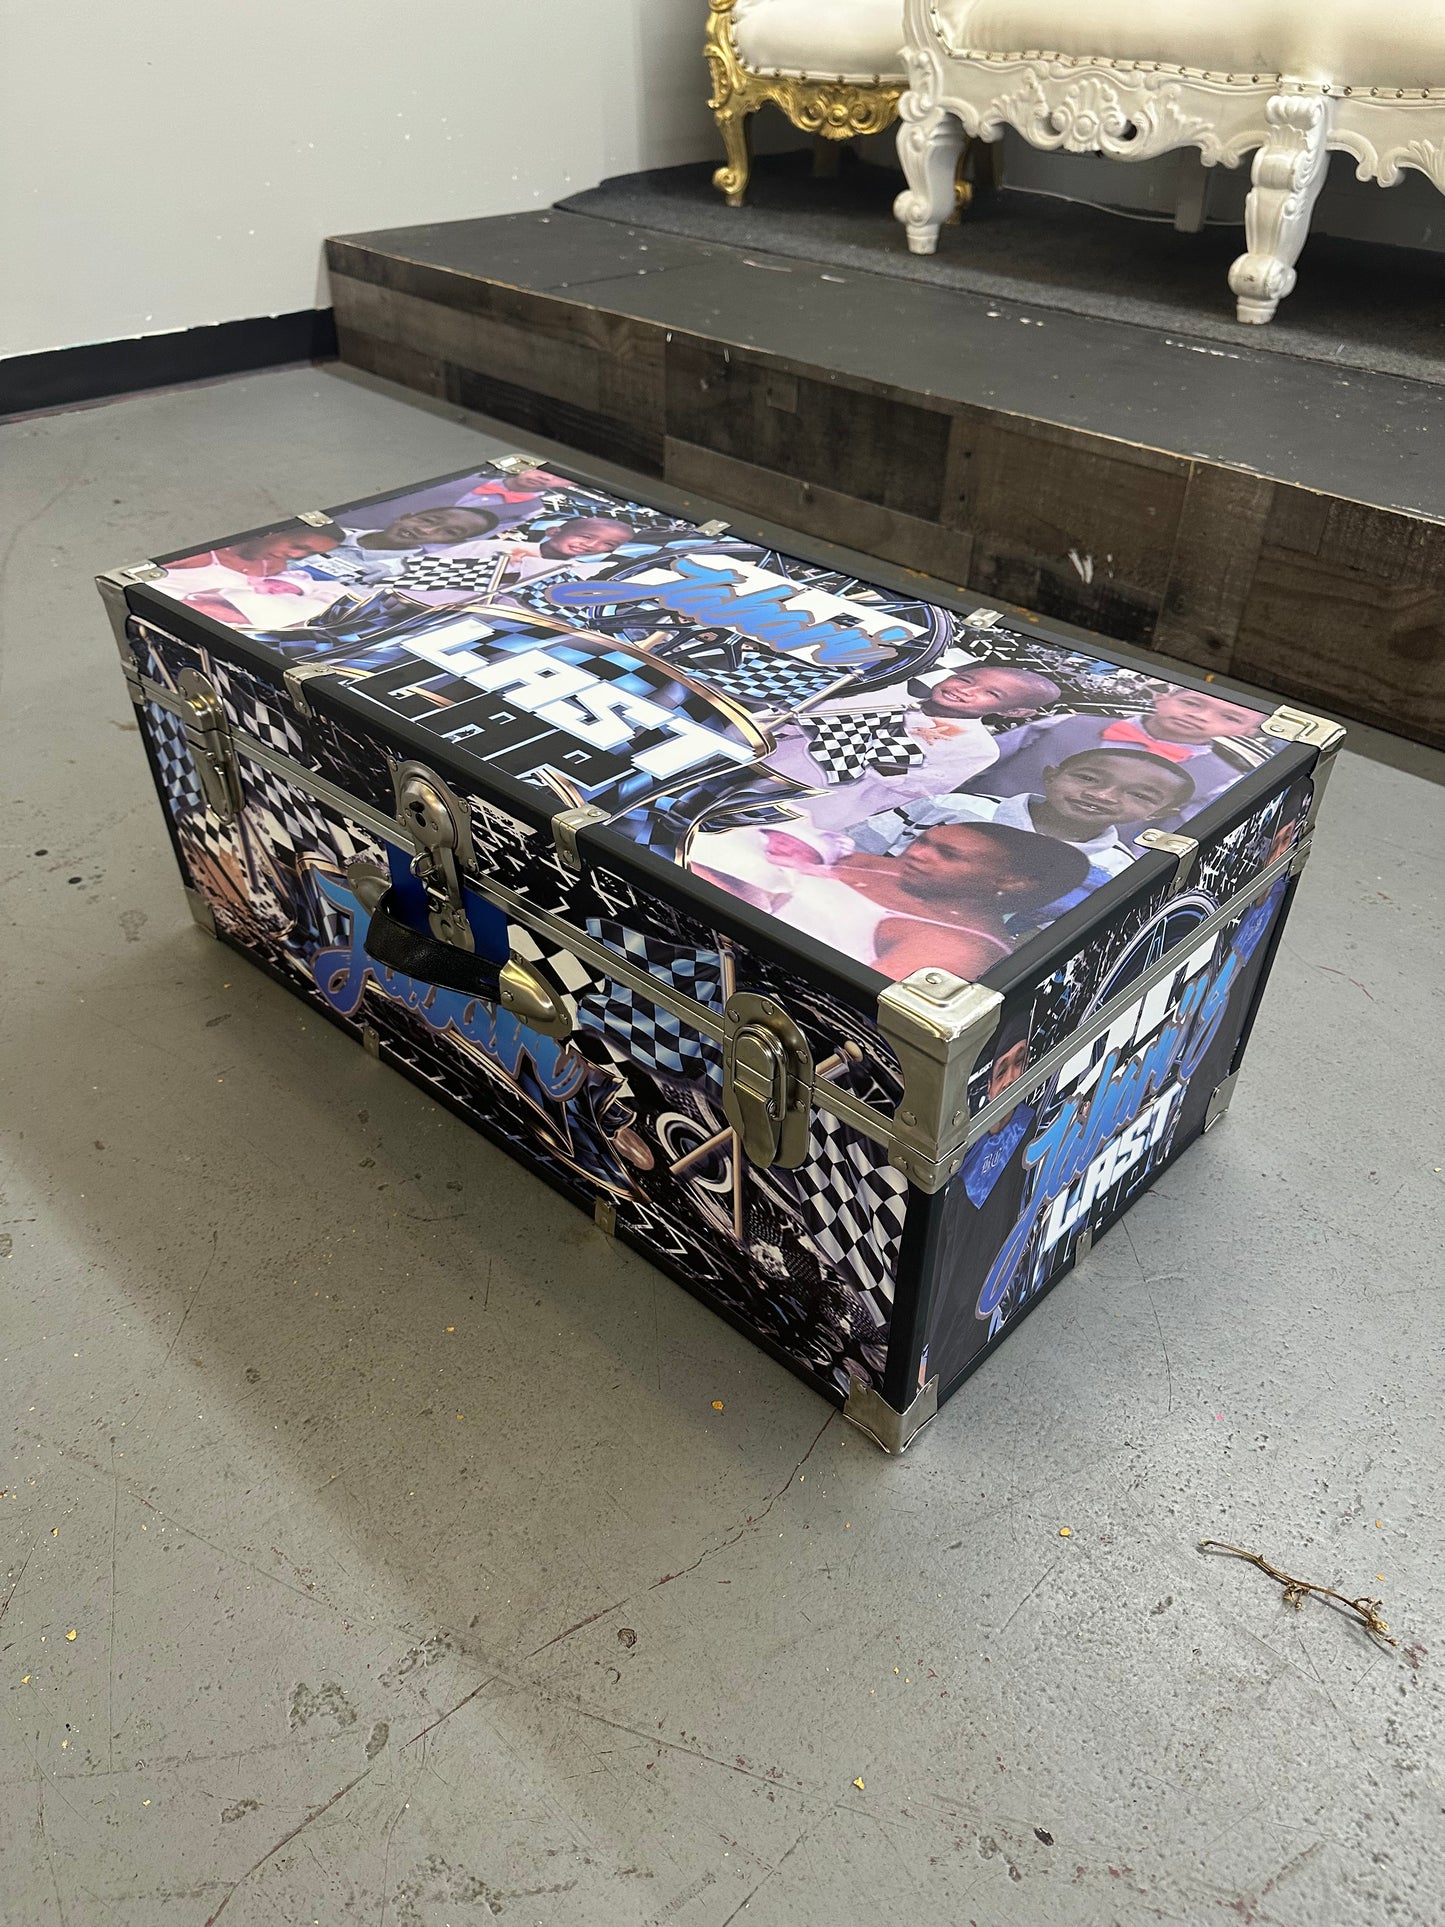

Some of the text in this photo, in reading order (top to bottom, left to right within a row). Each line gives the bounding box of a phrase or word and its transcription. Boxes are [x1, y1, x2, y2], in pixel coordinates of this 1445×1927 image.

[545, 556, 914, 666] Jabari
[345, 657, 636, 791] LAP
[396, 617, 761, 780] LAST
[1044, 1081, 1181, 1252] LAST
